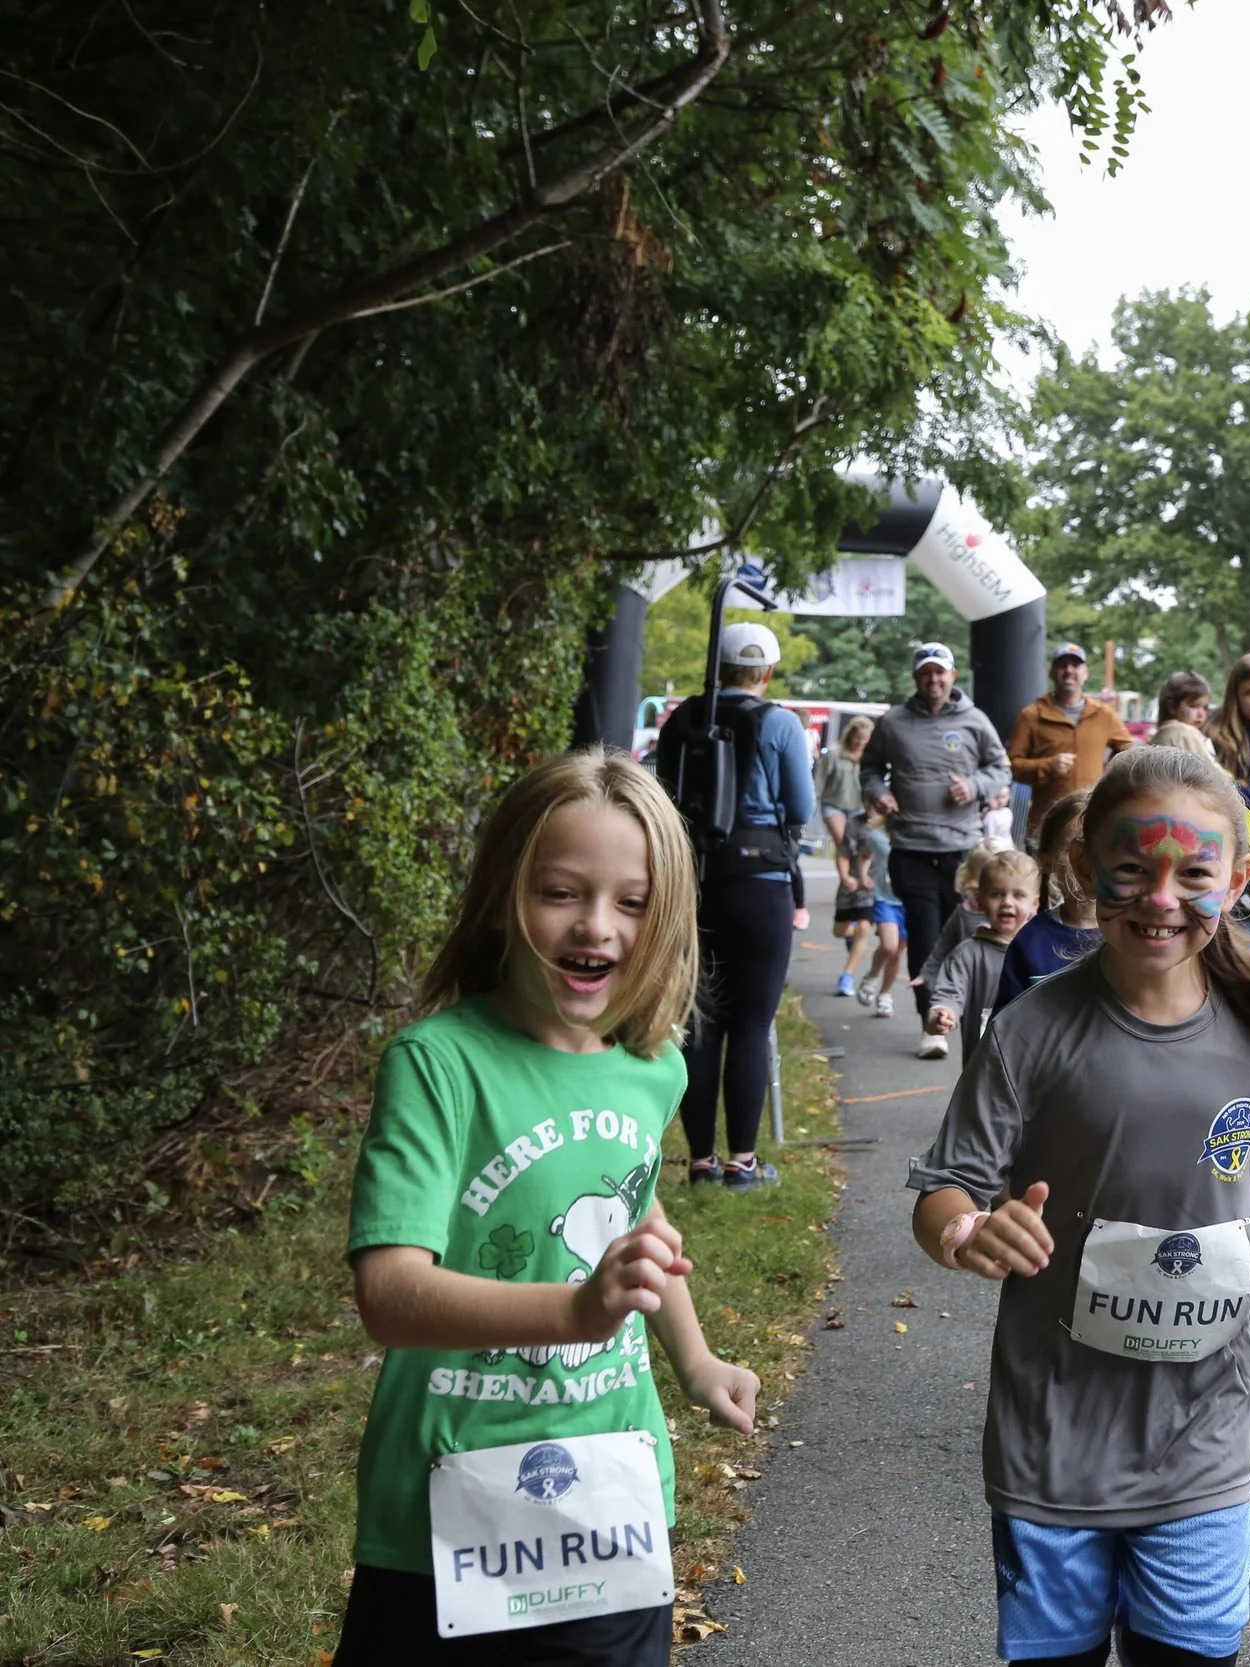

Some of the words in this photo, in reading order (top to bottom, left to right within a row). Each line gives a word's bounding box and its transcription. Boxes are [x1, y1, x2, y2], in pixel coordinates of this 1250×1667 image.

[937, 523, 1012, 602] High5EM
[1209, 1134, 1230, 1148] SAK
[461, 1118, 564, 1217] HERE
[569, 1109, 638, 1149] FOR
[1172, 1251, 1199, 1259] STRONG
[1089, 1292, 1163, 1326] FUN
[1173, 1296, 1243, 1326] RUN
[1141, 1338, 1202, 1350] DUFFY
[453, 1537, 544, 1582] FUN
[561, 1521, 653, 1567] RUN
[529, 1581, 607, 1607] DUFFY
